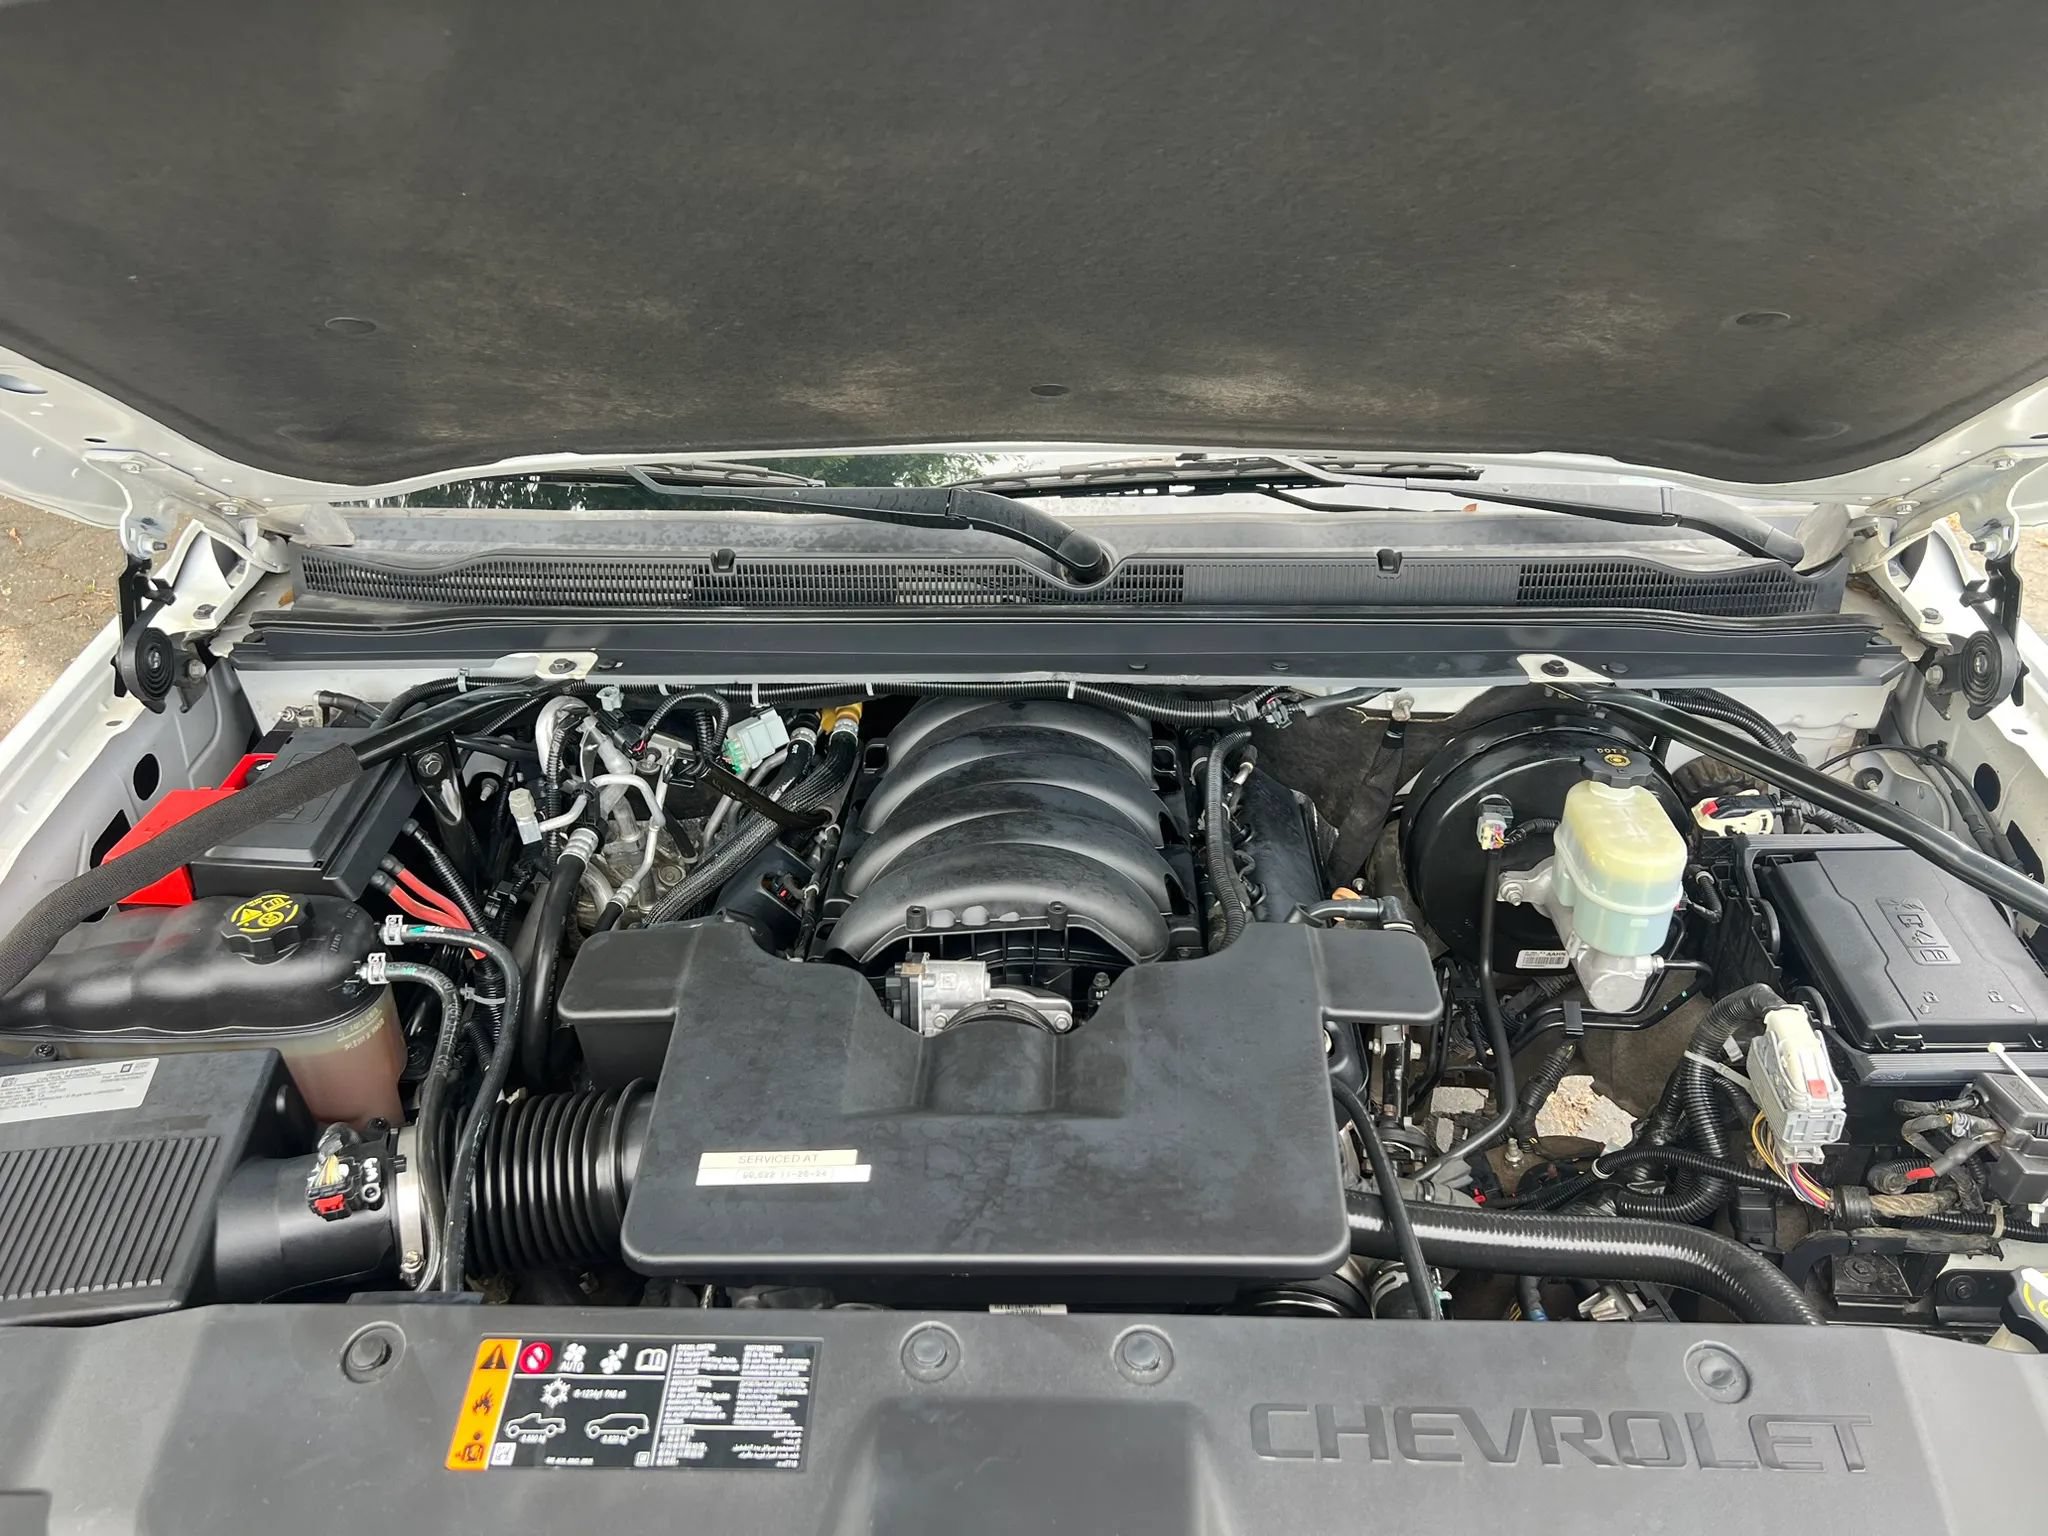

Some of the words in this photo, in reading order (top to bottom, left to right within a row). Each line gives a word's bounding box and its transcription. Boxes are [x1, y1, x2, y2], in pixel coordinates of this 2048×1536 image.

[738, 1154, 801, 1164] SERVICED
[803, 1153, 819, 1163] AT
[560, 1361, 585, 1373] AUTO
[1249, 1402, 1873, 1473] CHEVROLET
